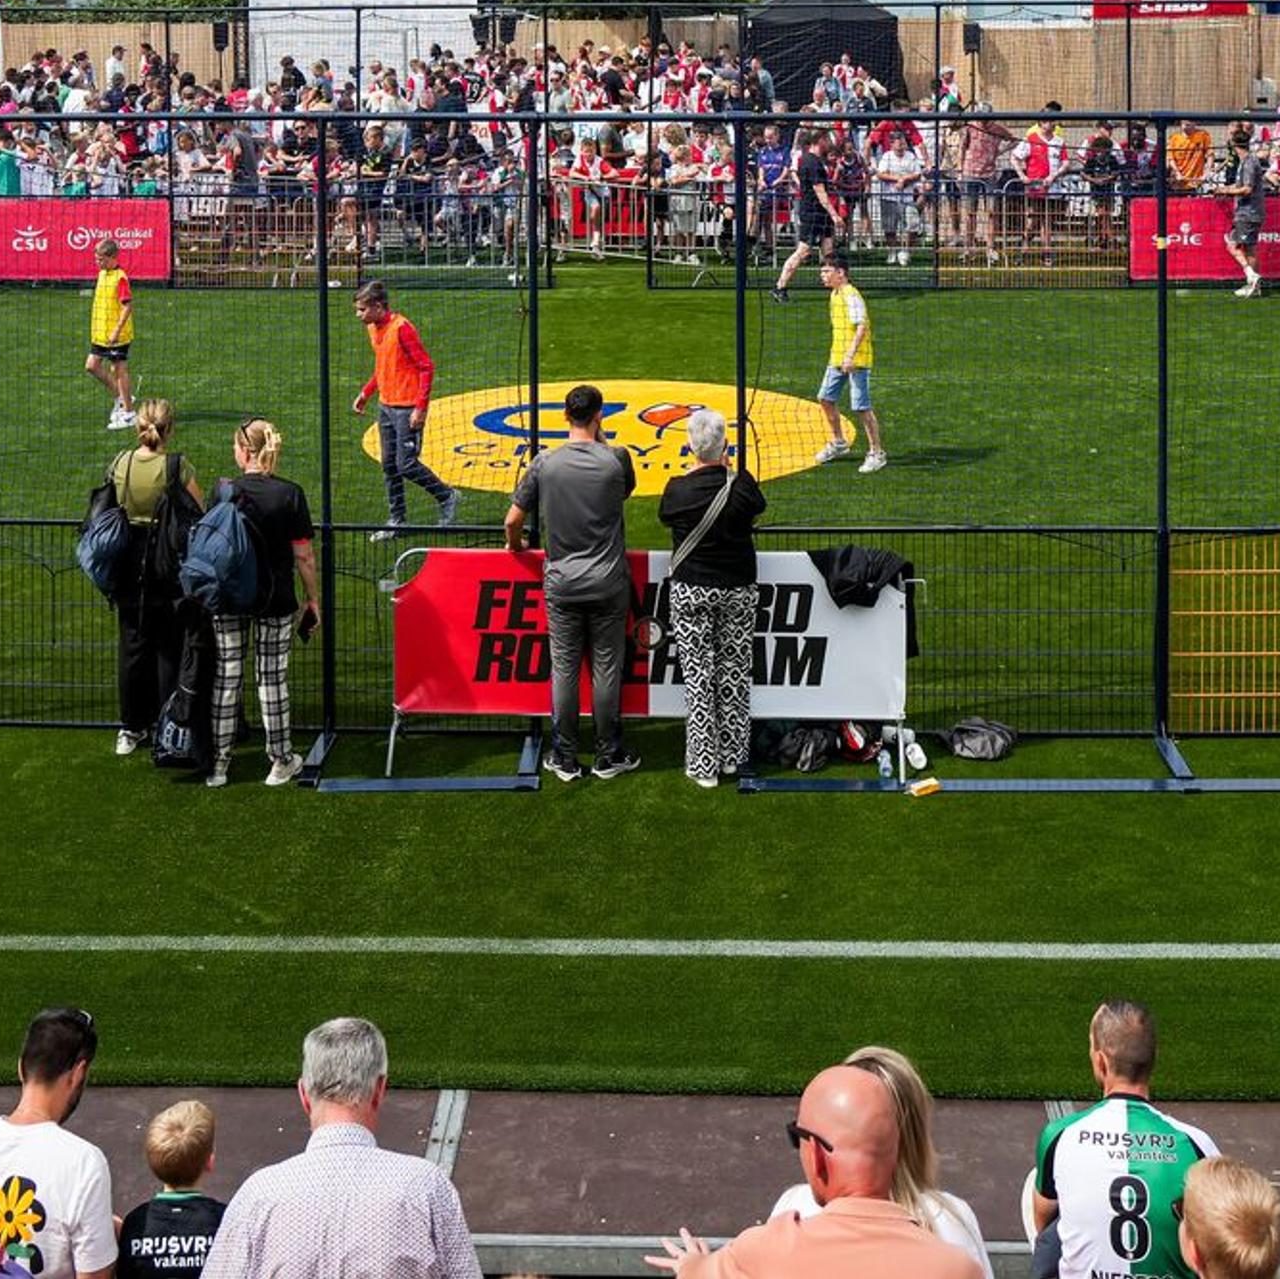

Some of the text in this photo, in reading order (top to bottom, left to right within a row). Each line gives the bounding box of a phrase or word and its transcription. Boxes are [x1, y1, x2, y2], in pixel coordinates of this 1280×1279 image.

[12, 240, 48, 252] CSU
[1108, 1150, 1177, 1162] vakanties
[1110, 1175, 1150, 1261] 8
